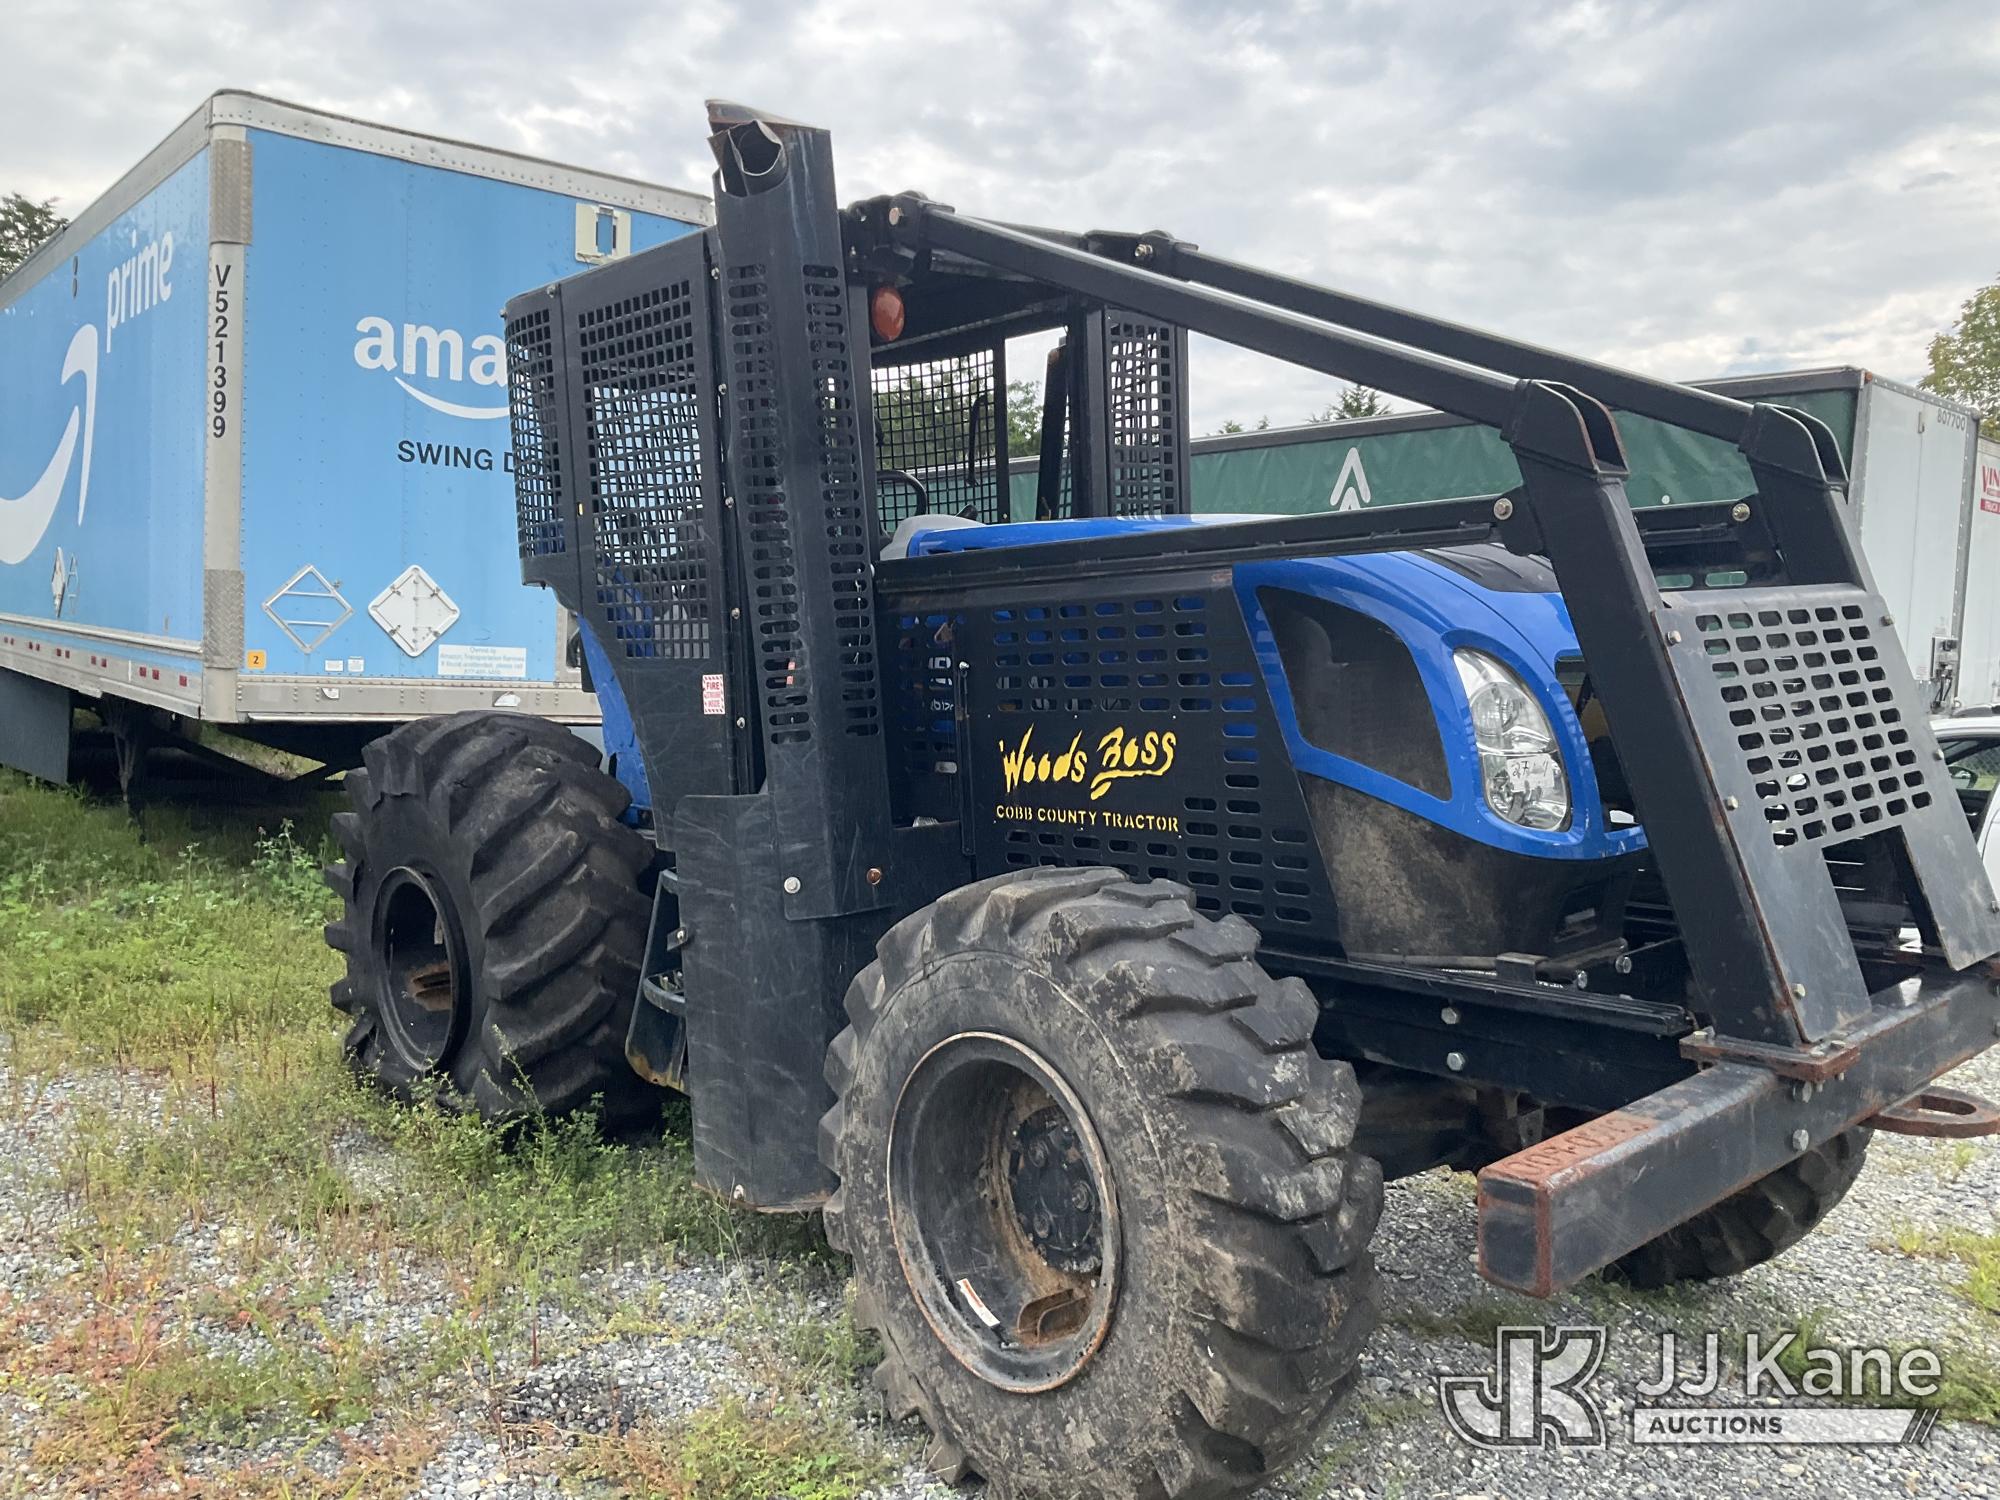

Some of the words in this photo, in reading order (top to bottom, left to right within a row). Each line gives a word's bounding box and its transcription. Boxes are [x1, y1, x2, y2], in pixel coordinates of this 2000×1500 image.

[106, 229, 173, 354] prime
[212, 264, 232, 439] V521399
[397, 439, 494, 471] SWING
[253, 655, 260, 665] 2
[706, 682, 720, 690] FIRE
[999, 722, 1088, 793] Woods
[996, 805, 1033, 821] COBB
[1037, 808, 1097, 826] COUNTY
[1102, 812, 1179, 833] TRACTOR
